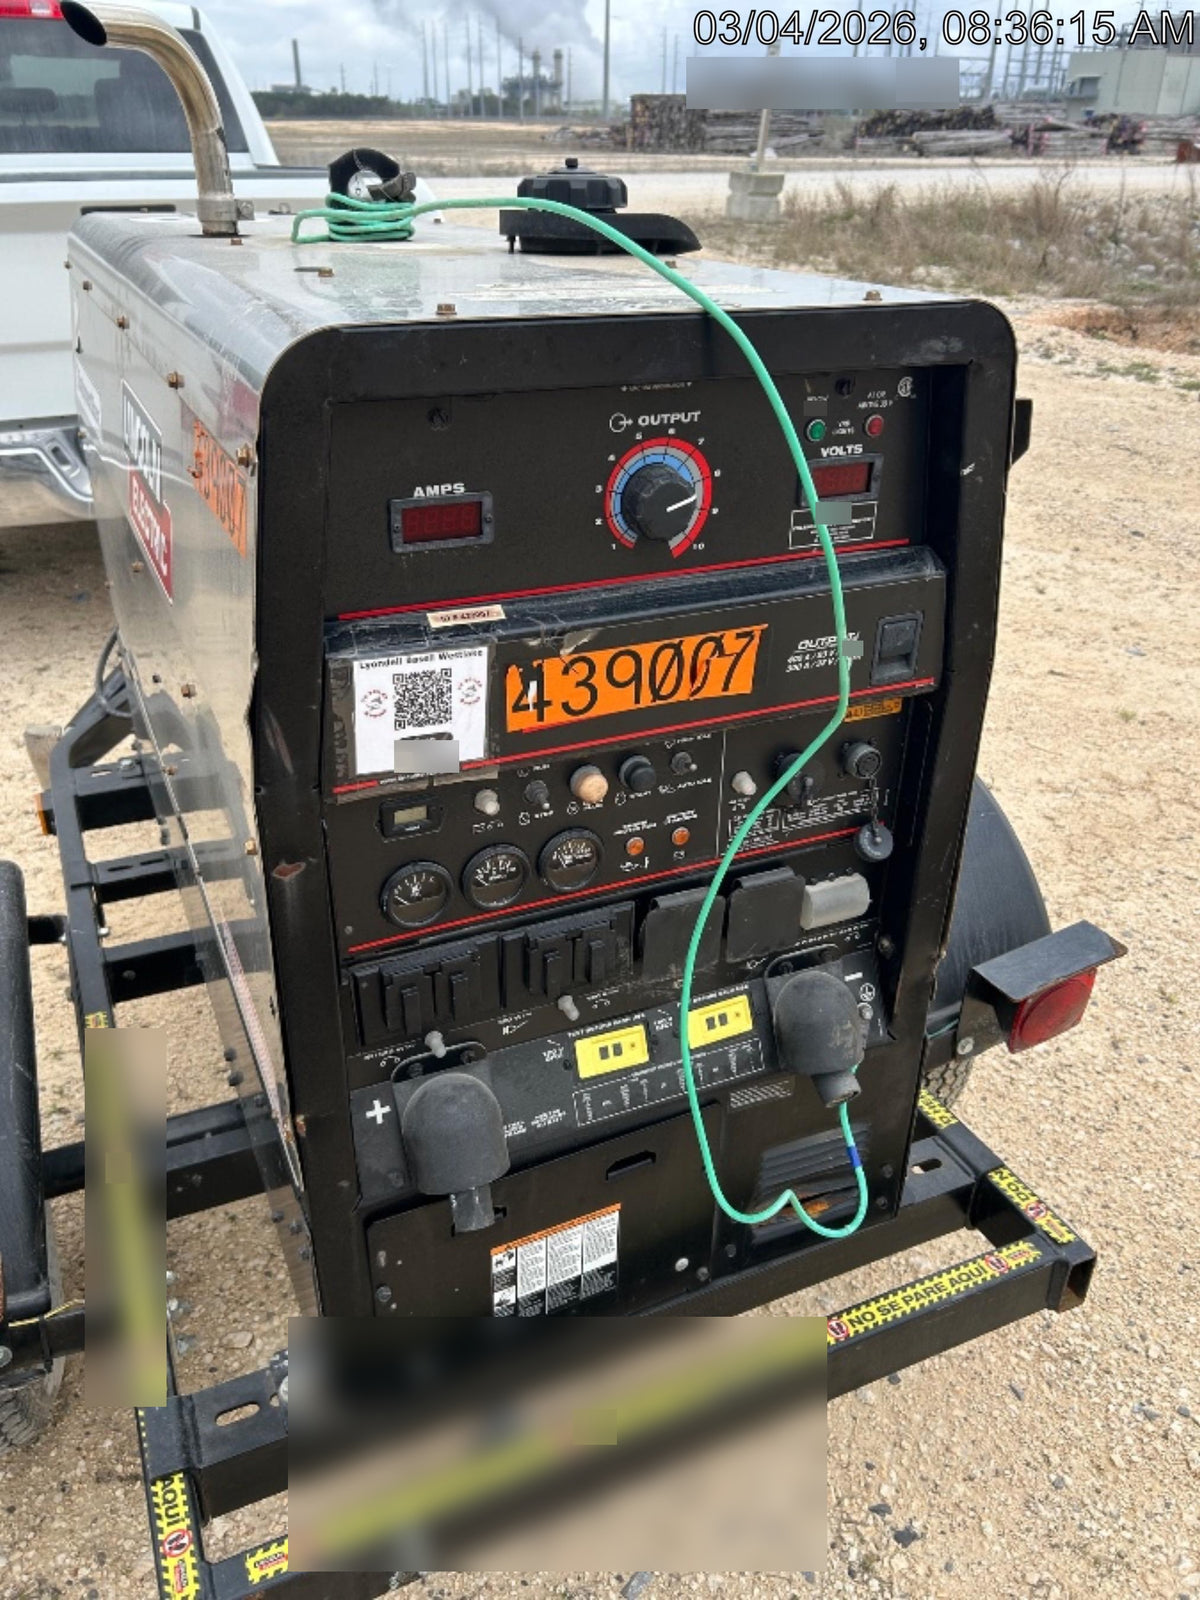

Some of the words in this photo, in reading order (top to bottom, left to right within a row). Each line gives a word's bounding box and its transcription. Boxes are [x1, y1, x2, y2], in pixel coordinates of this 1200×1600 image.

[638, 411, 701, 426] OUTPUT
[821, 444, 863, 457] VOLTS
[413, 483, 465, 498] AMPS
[512, 630, 755, 723] 439007
[848, 1309, 877, 1330] NO
[877, 1300, 901, 1320] SE
[902, 1282, 947, 1310] PARE
